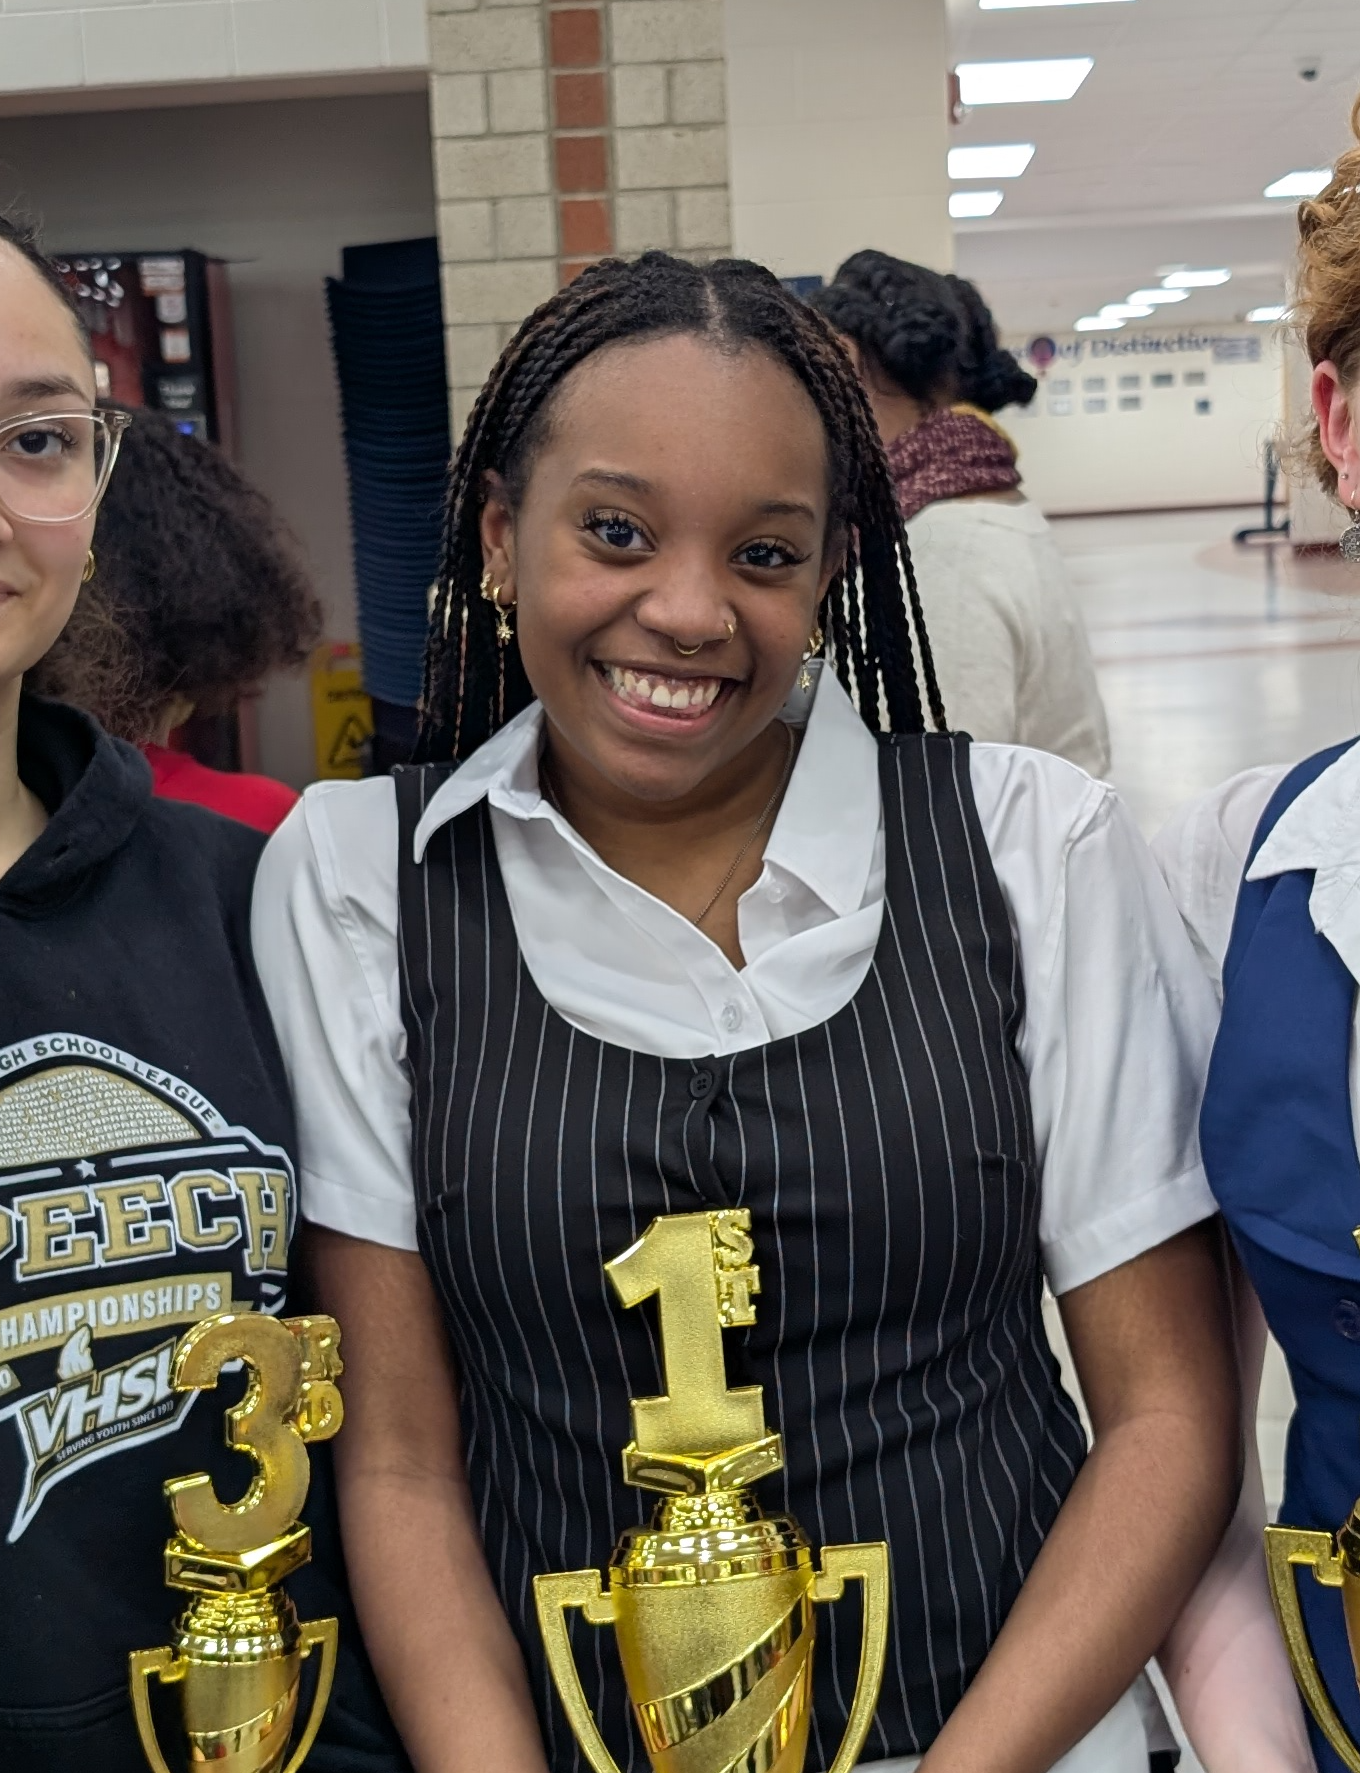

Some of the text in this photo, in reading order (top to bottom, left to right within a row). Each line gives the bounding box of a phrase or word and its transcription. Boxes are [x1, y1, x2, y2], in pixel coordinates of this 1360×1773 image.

[3, 1074, 109, 1103] STORYTELLING
[13, 1069, 93, 1094] IMPROMPTU
[32, 1037, 127, 1068] SCHOOL
[132, 1061, 218, 1124] LEAGUE
[60, 1081, 125, 1100] ORATORY
[28, 1088, 141, 1115] INTERPRETATION
[33, 1096, 152, 1123] INTERPRETATION
[99, 1103, 163, 1118] SPEAKING
[28, 1128, 57, 1138] DUO
[60, 1109, 173, 1134] INTERPRETATION
[42, 1135, 70, 1144] DUO
[72, 1116, 182, 1141] INTERPRETATION
[20, 1140, 83, 1155] DRAMATIC
[85, 1122, 190, 1144] INTERPRETATION
[34, 1147, 94, 1161] DRAMATIC
[96, 1130, 195, 1151] INTERPRETATION
[28, 1346, 173, 1456] VHSL
[55, 1434, 96, 1463] SERVING
[96, 1422, 131, 1440] YOUTH
[131, 1408, 156, 1428] SINCE
